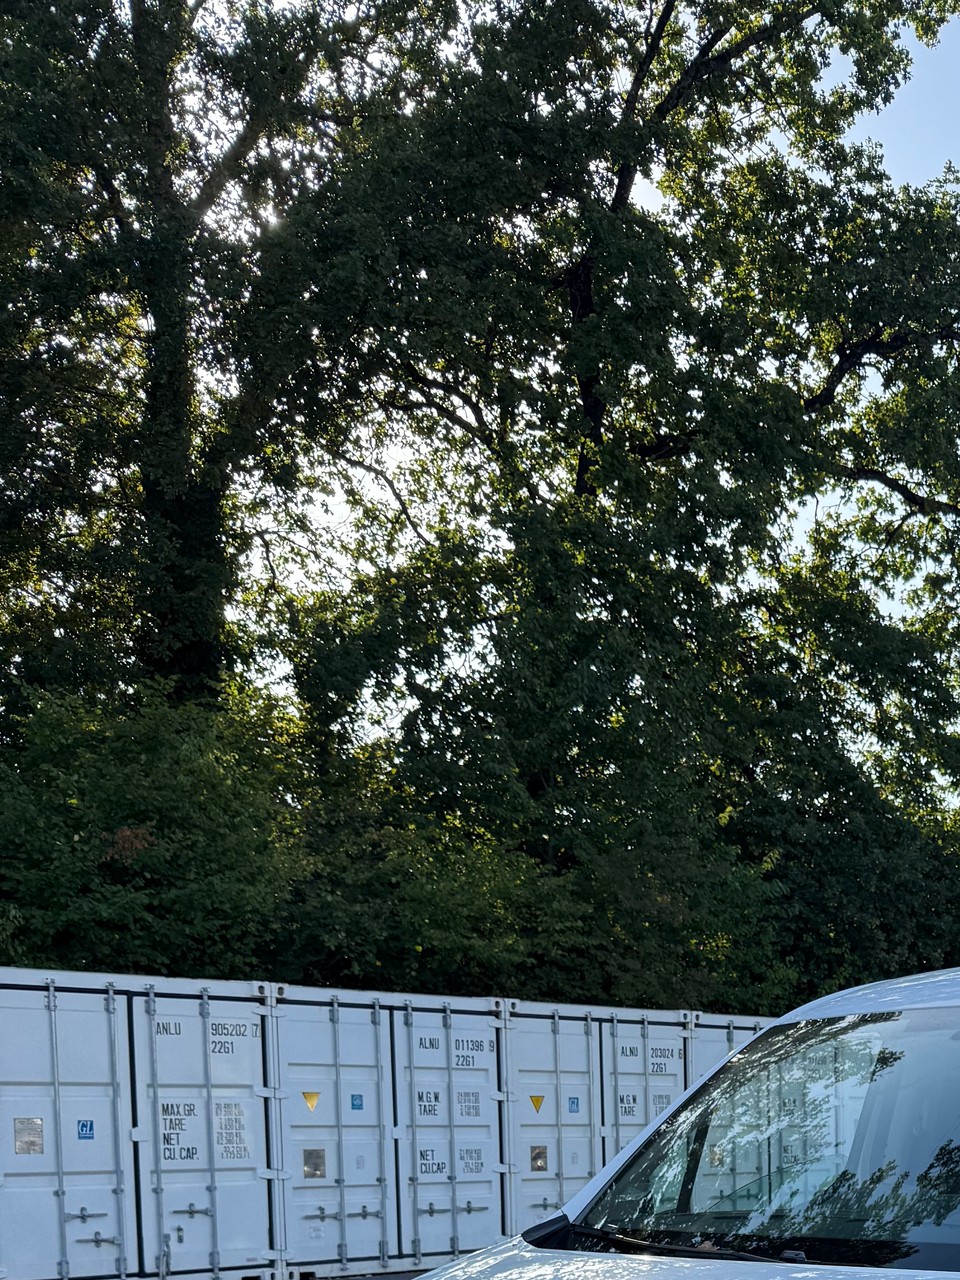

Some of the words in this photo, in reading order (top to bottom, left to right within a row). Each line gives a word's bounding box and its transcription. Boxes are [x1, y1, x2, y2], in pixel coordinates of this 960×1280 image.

[156, 1022, 181, 1036] ANLU
[211, 1023, 248, 1037] 905202
[418, 1037, 440, 1050] ALNU
[455, 1039, 485, 1052] 011396
[621, 1046, 638, 1057] ALNU
[651, 1047, 674, 1059] 203024
[418, 1104, 439, 1116] TARE
[620, 1106, 636, 1117] TARE
[79, 1121, 93, 1134] GL
[162, 1118, 187, 1131] TARE
[163, 1132, 180, 1146] NET
[419, 1149, 435, 1161] NET
